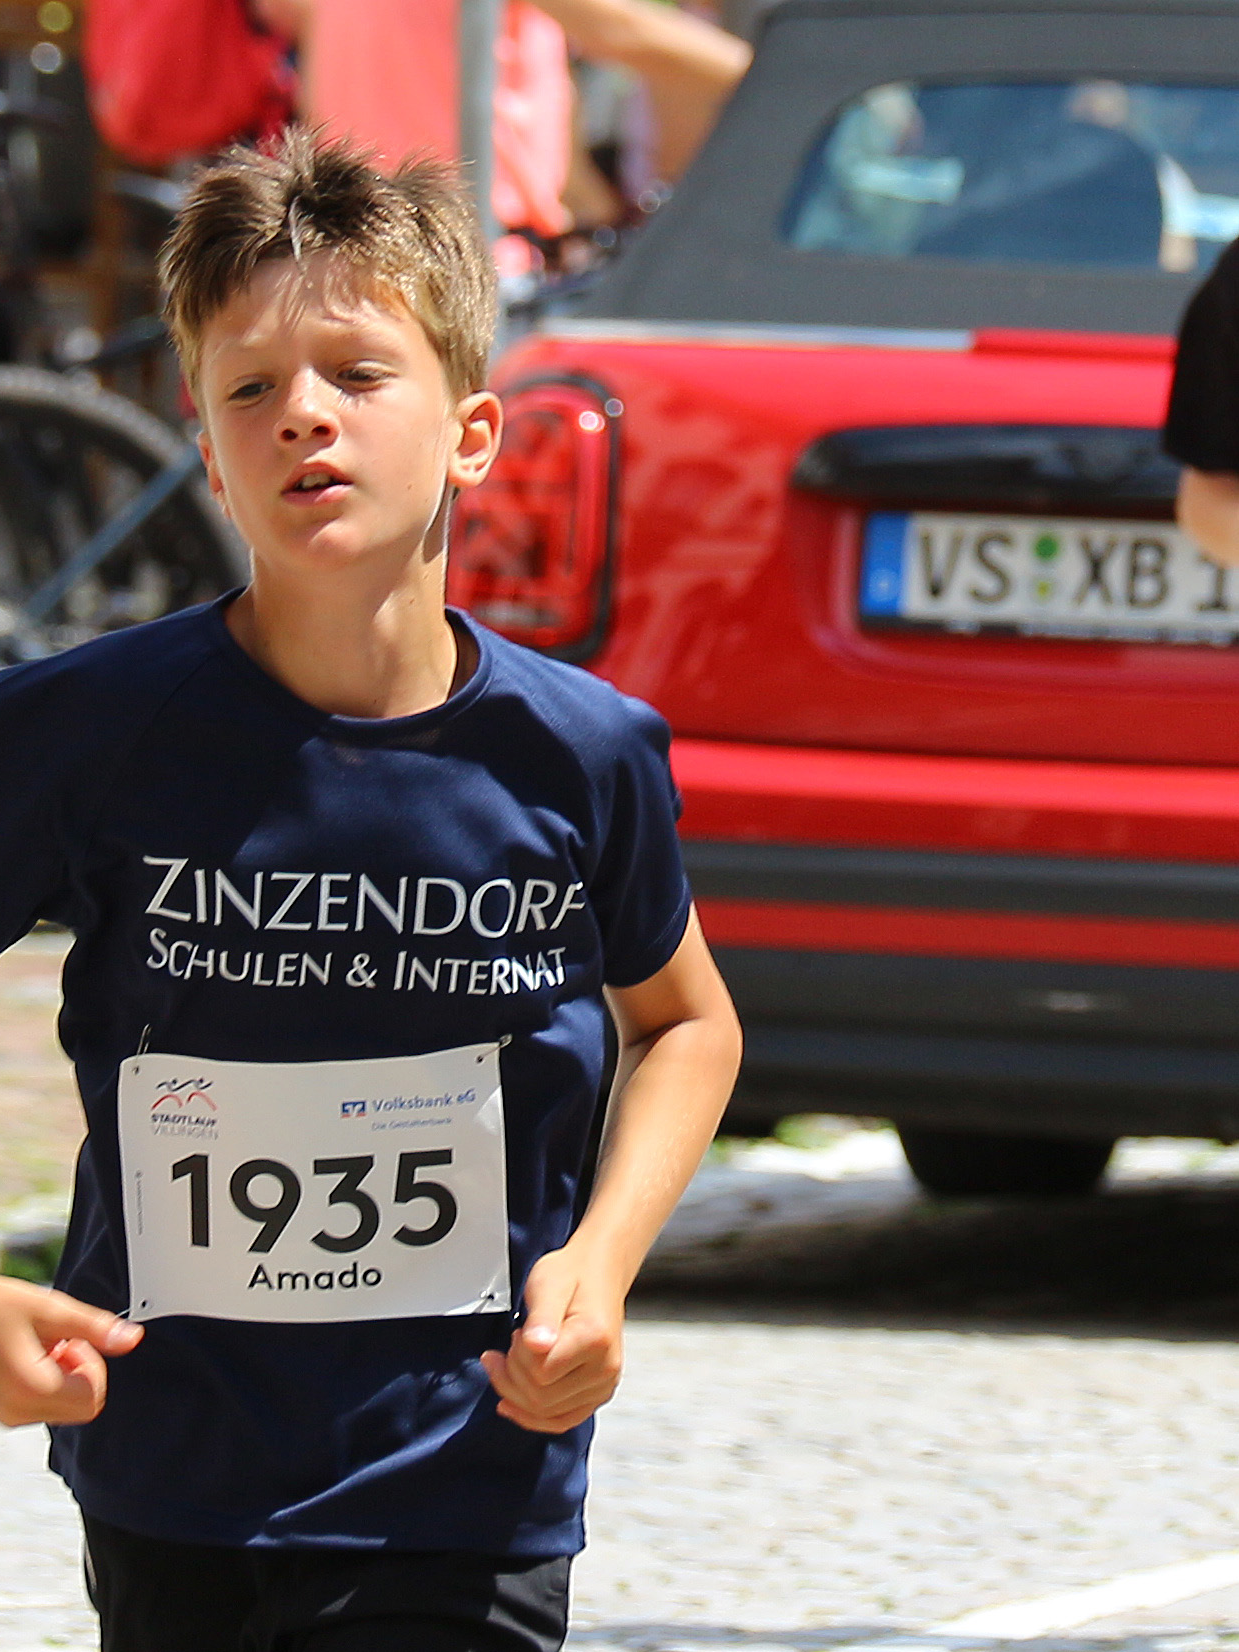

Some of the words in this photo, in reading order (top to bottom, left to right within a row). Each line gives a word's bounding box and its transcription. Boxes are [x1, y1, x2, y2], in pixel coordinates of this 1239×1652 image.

[920, 530, 1014, 604] VS
[1076, 536, 1168, 608] XB
[142, 854, 587, 939] ZINZENDORF
[146, 926, 334, 988] SCHULEN
[345, 952, 377, 989] &
[393, 946, 567, 996] INTERNAT
[372, 1092, 452, 1113] Volksbank
[456, 1087, 477, 1104] eG
[171, 1148, 458, 1254] 1935
[247, 1261, 383, 1291] Amado
